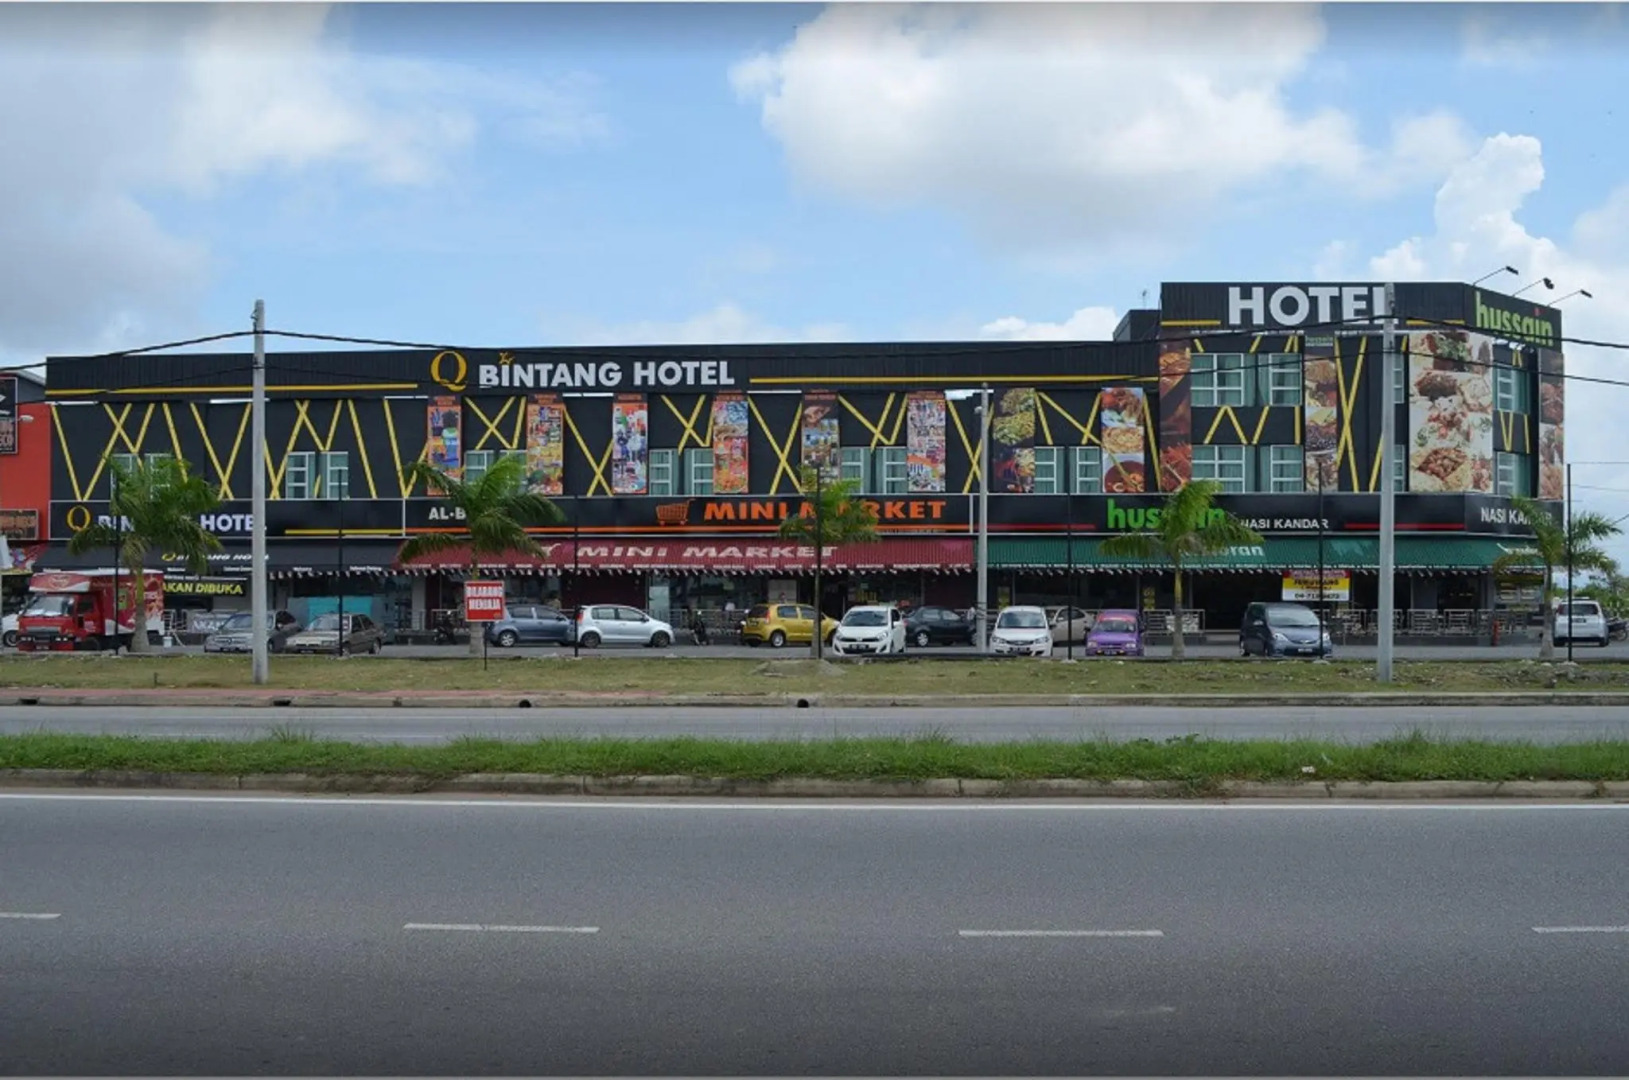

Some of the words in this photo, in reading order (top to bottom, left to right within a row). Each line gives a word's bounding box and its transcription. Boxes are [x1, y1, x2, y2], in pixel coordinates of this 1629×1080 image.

[1228, 286, 1398, 326] HOTEL
[1475, 290, 1554, 347] hussain
[479, 362, 623, 388] BINTANG
[633, 361, 735, 386] HOTEL
[704, 502, 786, 520] MINI
[1481, 506, 1506, 524] NASI
[200, 513, 267, 532] HOTE
[577, 546, 667, 558] MINI
[682, 546, 838, 558] MARKET
[195, 583, 243, 595] DIBUKA
